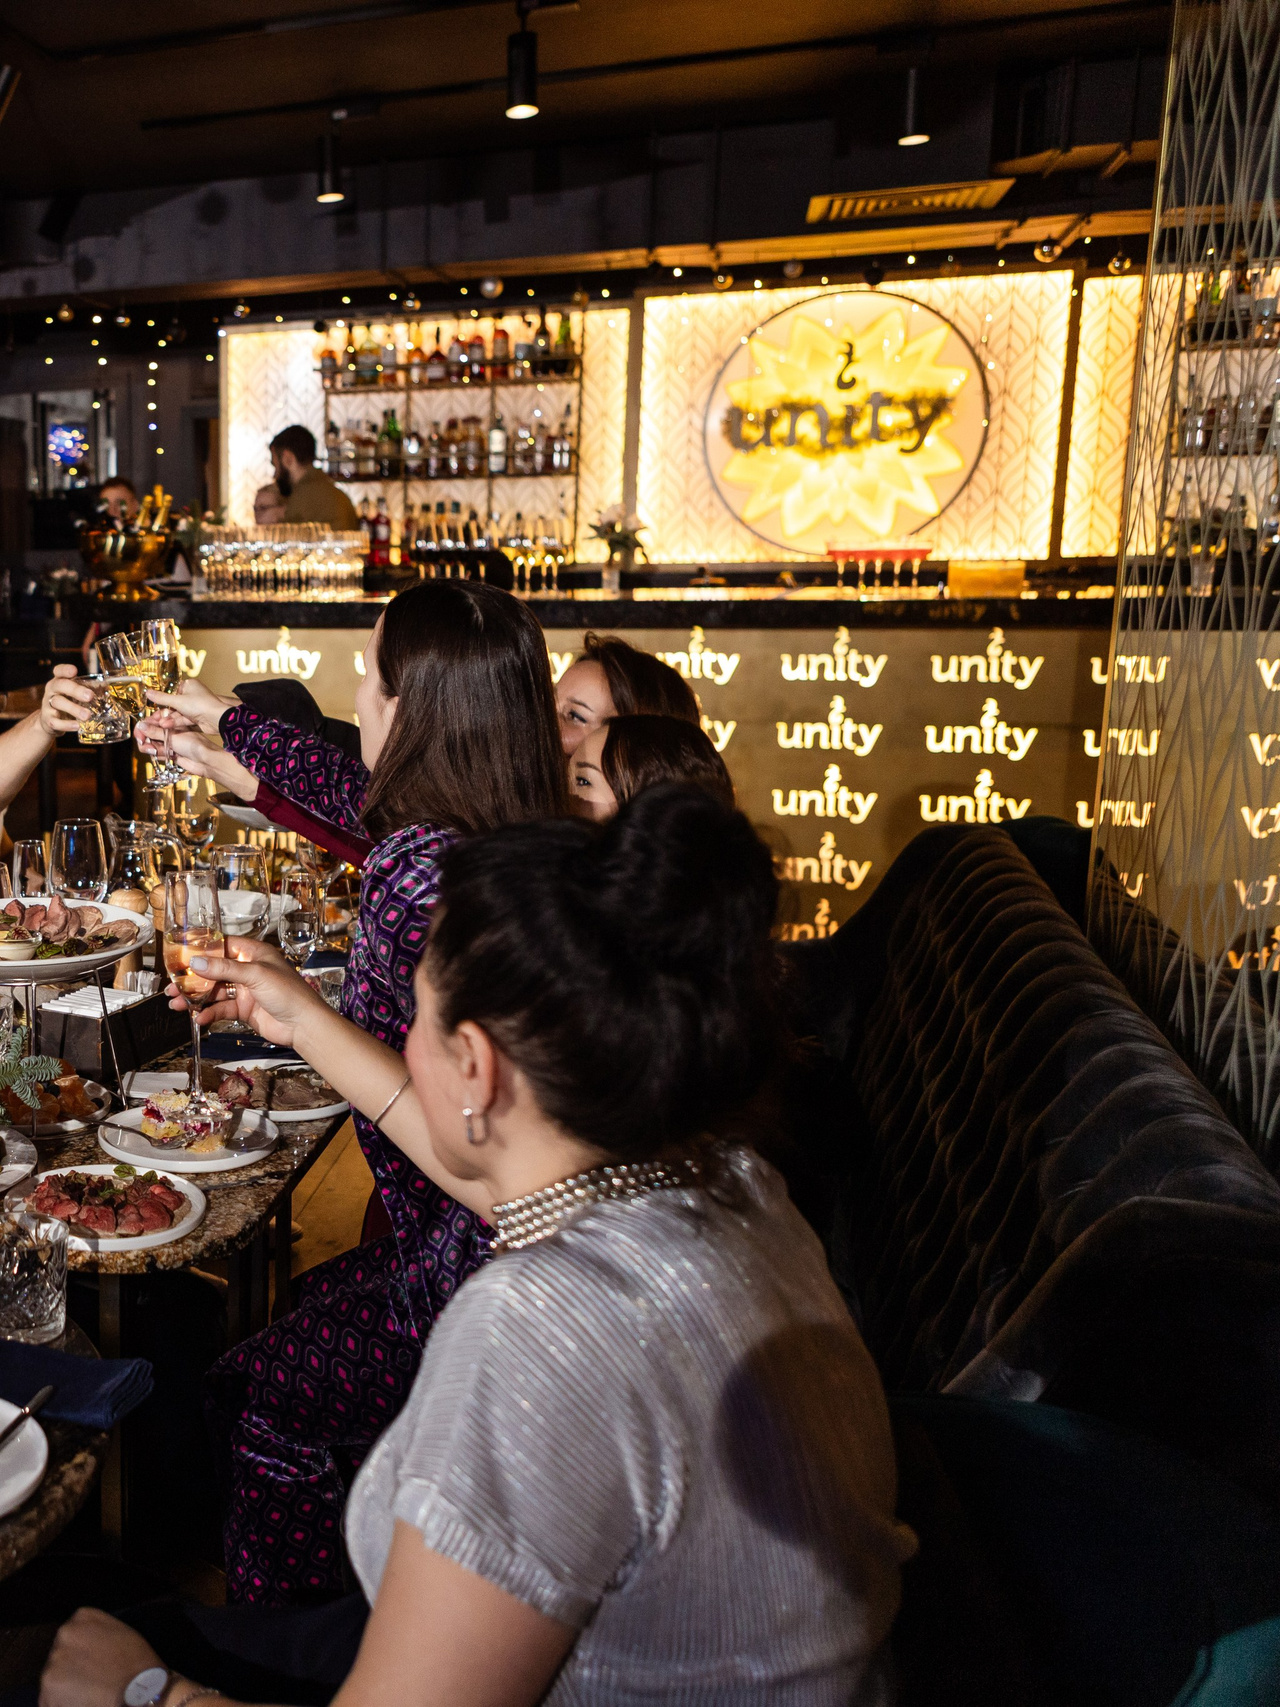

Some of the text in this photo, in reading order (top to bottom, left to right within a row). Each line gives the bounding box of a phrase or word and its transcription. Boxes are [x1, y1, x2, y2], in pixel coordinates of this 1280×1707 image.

[721, 342, 956, 454] unity
[236, 626, 322, 680] unity
[780, 626, 888, 688] unity
[930, 627, 1044, 690] unity
[776, 695, 883, 757] unity
[925, 698, 1038, 761] unity
[771, 763, 878, 824] unity
